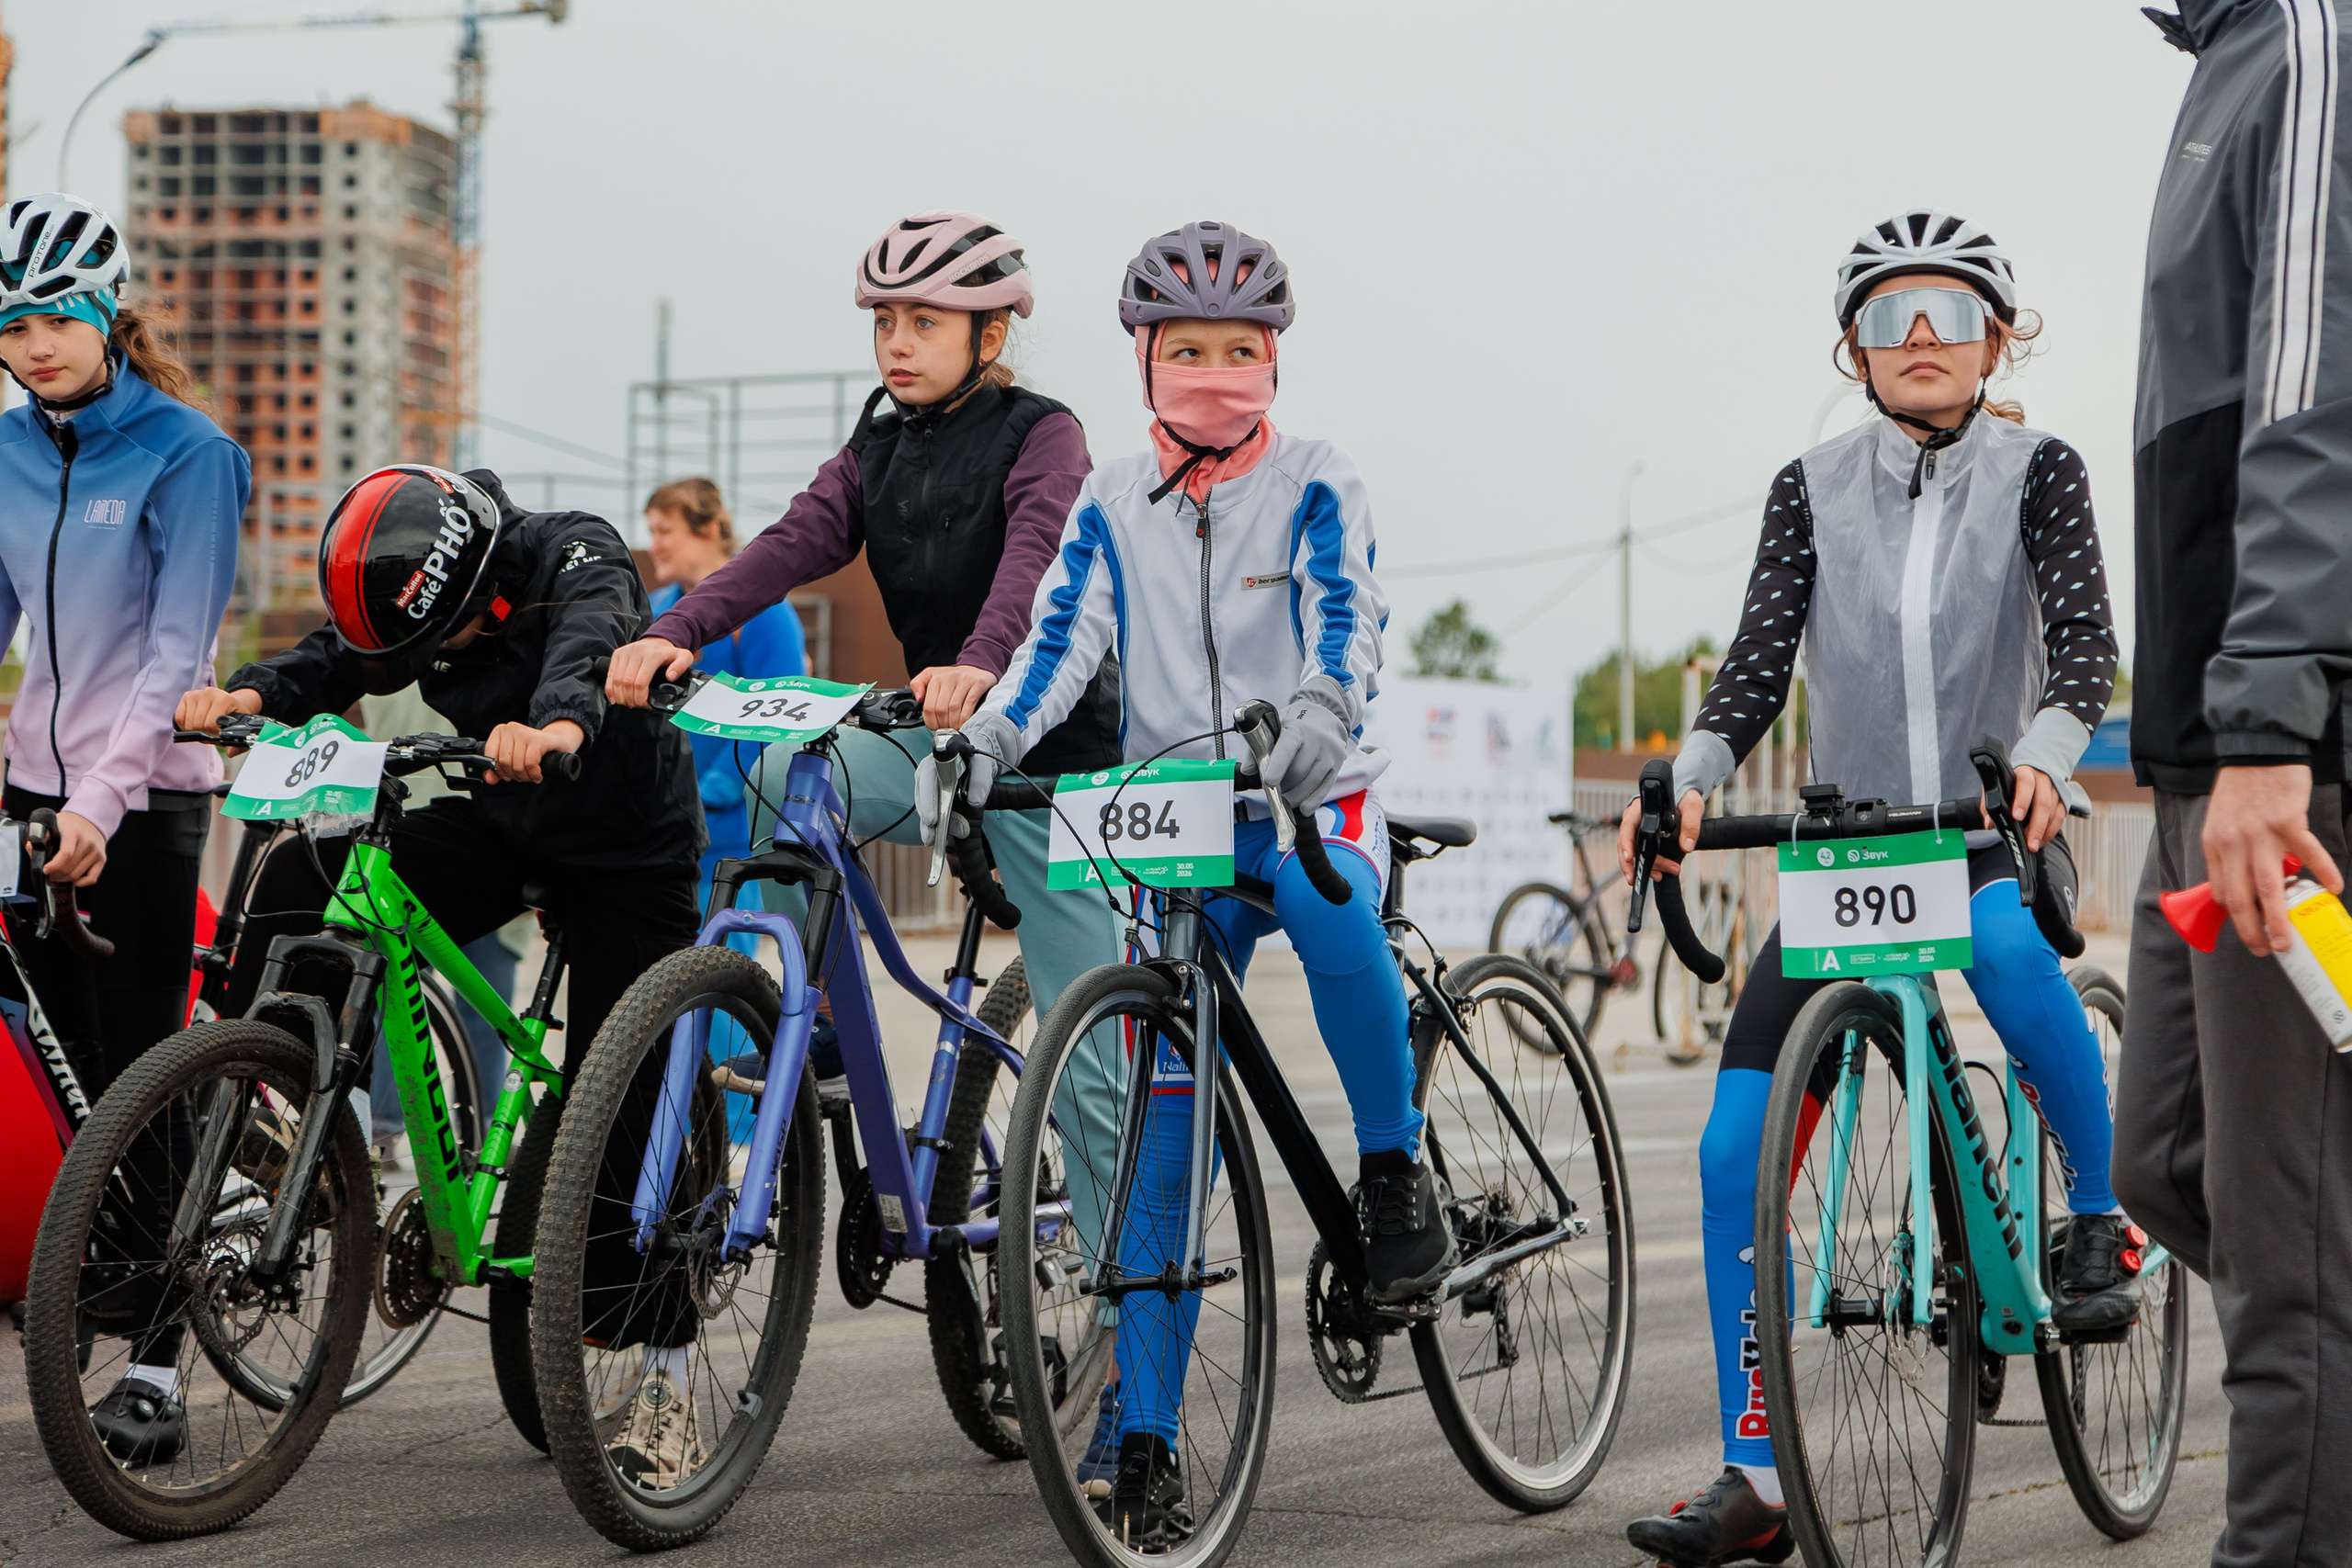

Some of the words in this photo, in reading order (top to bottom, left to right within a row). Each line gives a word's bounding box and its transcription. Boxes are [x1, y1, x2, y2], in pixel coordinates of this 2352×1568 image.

[948, 254, 989, 282] ROCKBROS
[407, 576, 443, 619] Café
[738, 698, 813, 722] 934
[705, 724, 721, 734] A
[284, 740, 339, 788] 889
[255, 801, 272, 816] A
[1098, 800, 1181, 841] 884
[1862, 851, 1890, 862] Звук
[2006, 829, 2025, 869] 105
[1084, 863, 1102, 882] A
[1835, 884, 1917, 928] 890
[1822, 950, 1841, 972] A
[1918, 947, 1936, 955] 30.05
[1928, 1007, 2022, 1262] Bianchi
